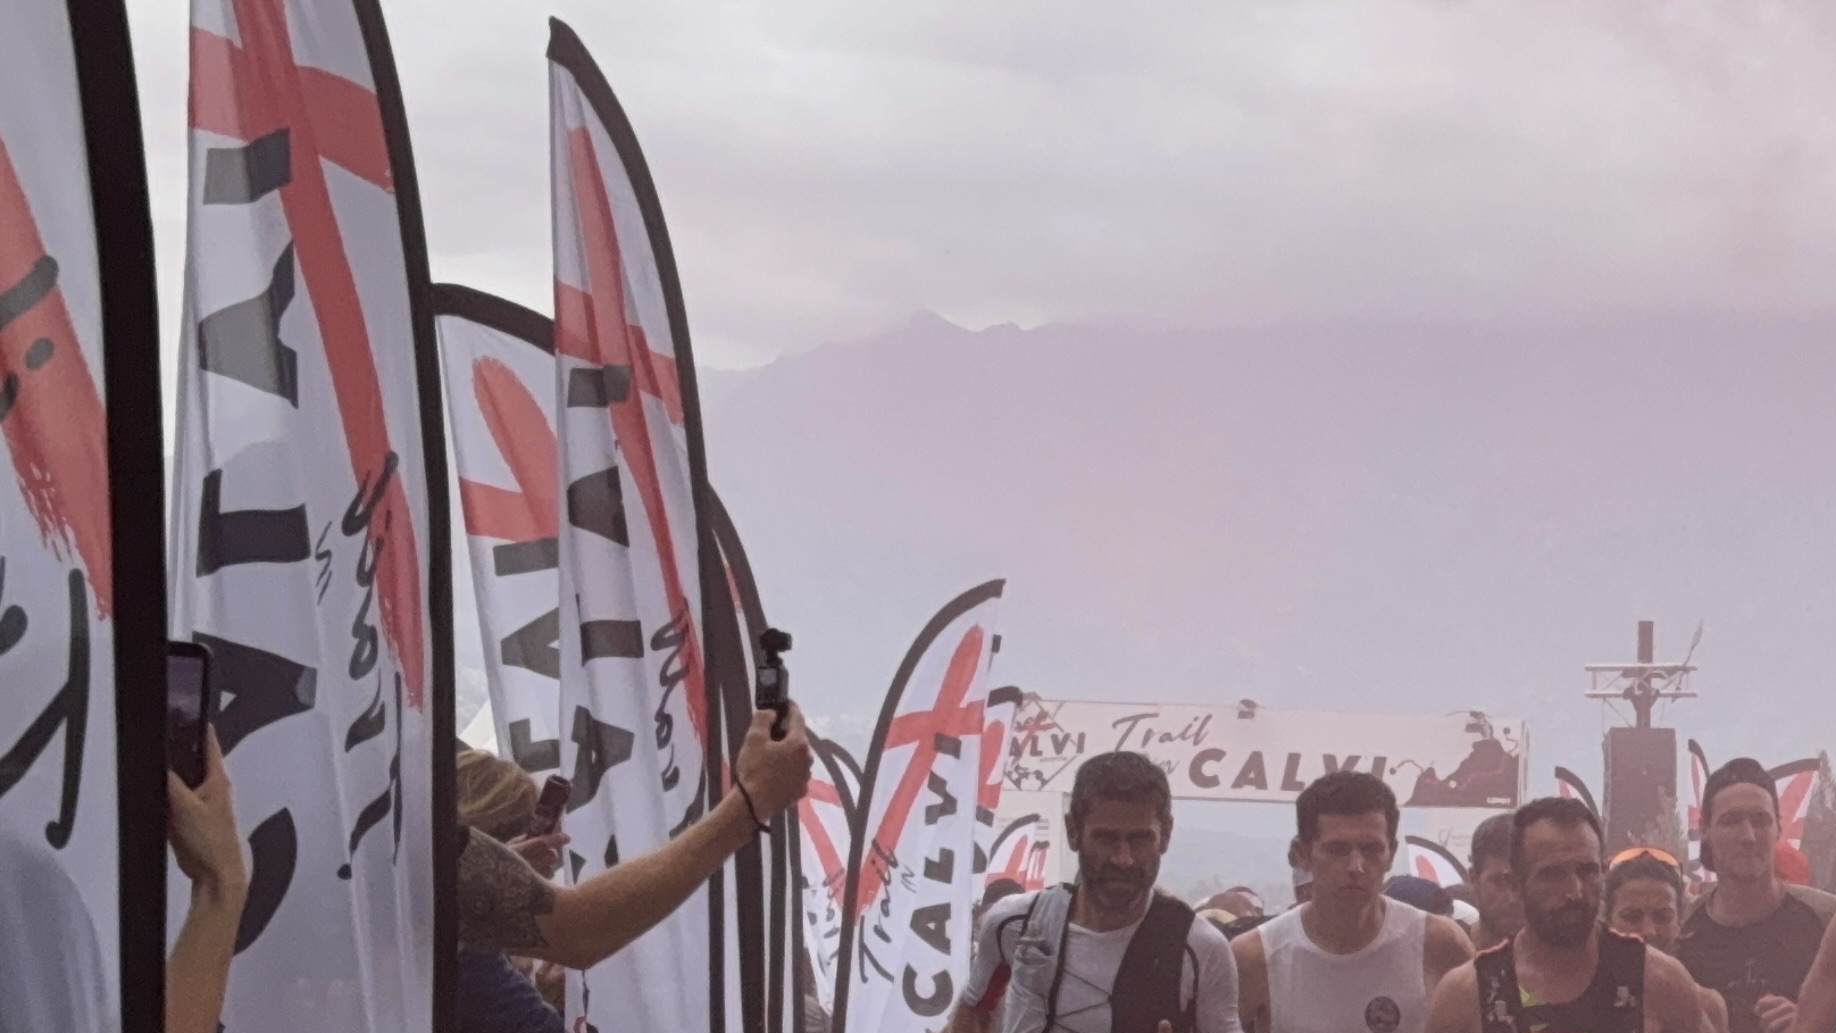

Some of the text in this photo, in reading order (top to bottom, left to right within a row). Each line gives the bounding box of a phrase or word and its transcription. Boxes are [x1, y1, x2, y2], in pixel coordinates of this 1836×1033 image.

[1009, 732, 1086, 757] ALVI
[1112, 713, 1216, 751] Trail
[860, 838, 898, 984] Trail
[902, 731, 961, 1018] CALVI
